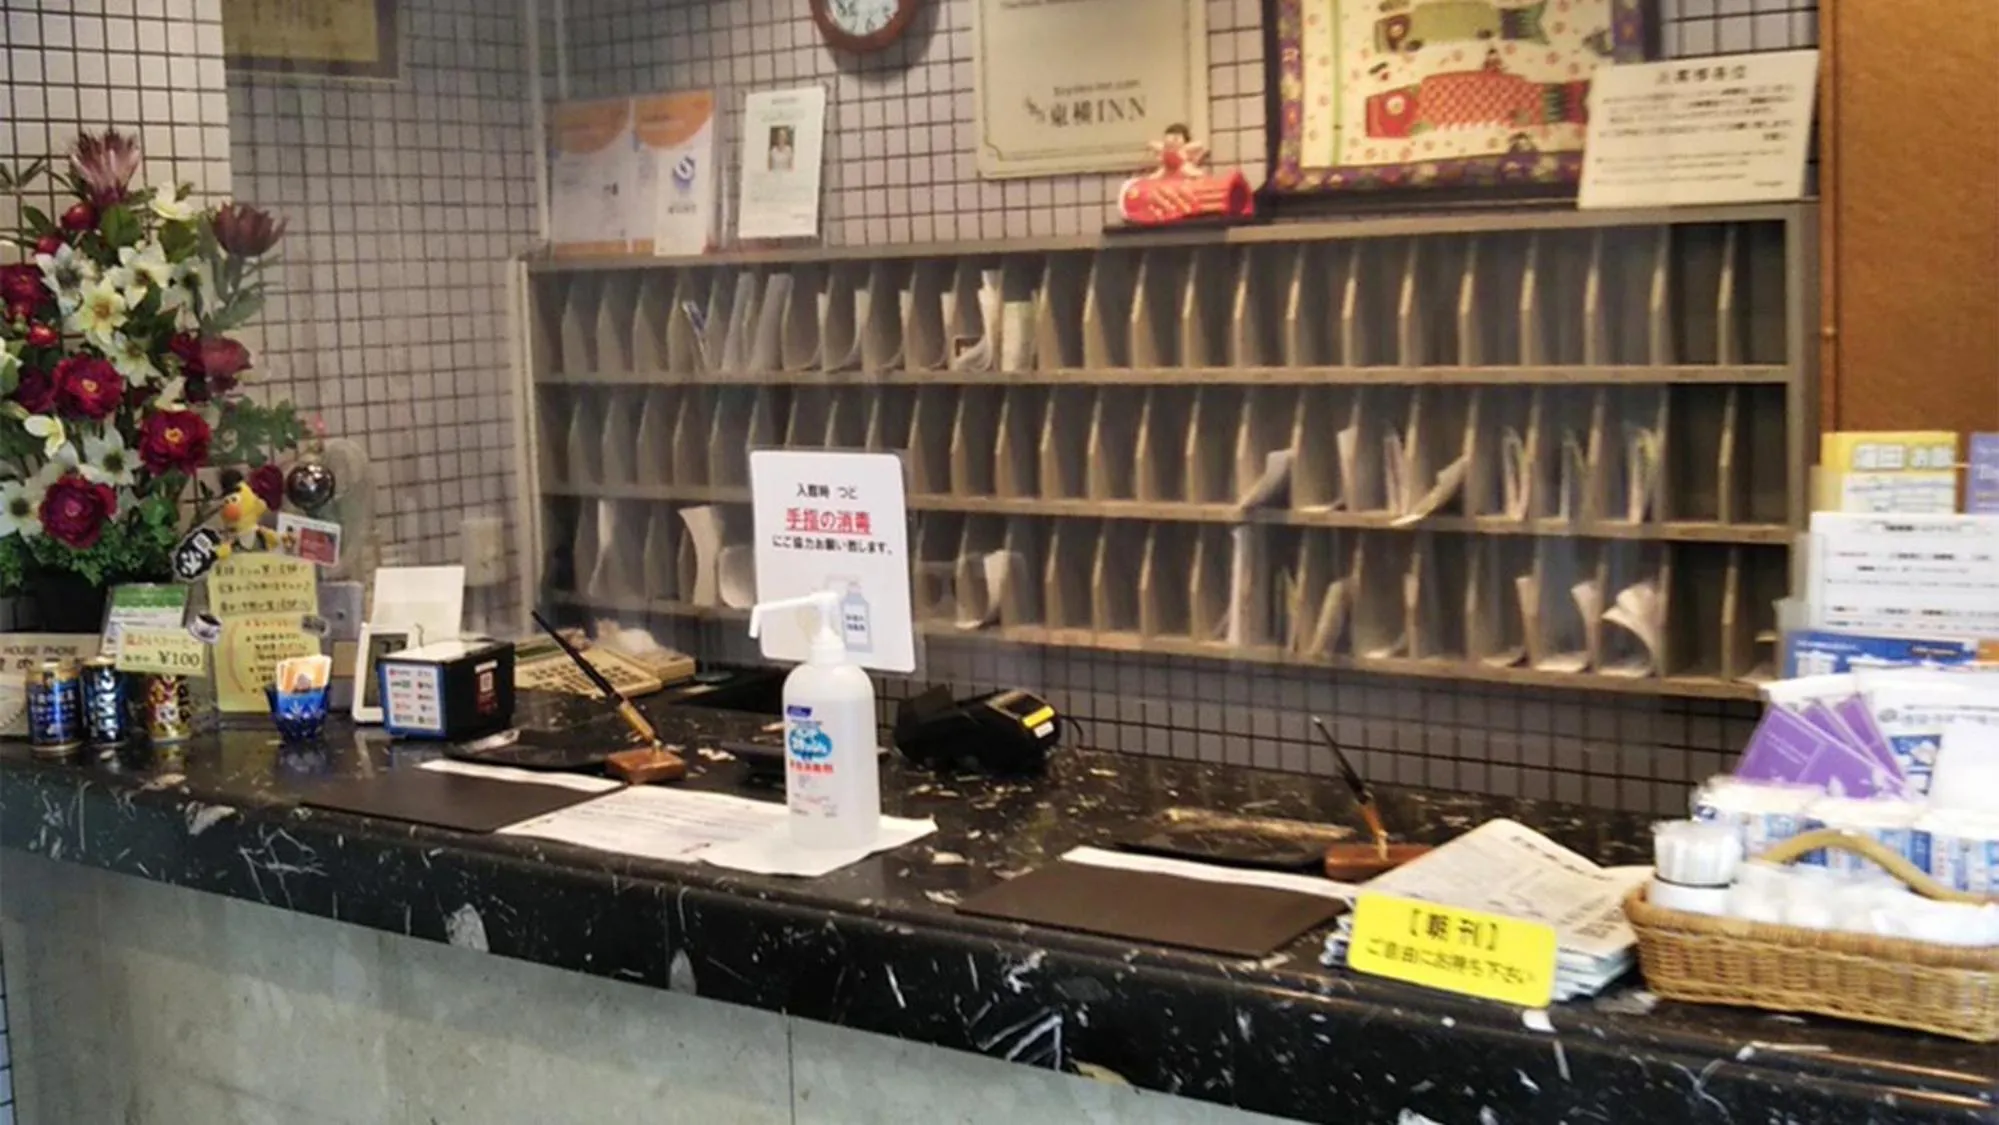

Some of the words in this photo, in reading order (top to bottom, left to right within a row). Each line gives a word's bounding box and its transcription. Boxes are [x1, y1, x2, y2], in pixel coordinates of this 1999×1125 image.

[786, 508, 871, 534] 手指の消毒
[772, 535, 893, 555] にご協力お願い致します。
[158, 650, 201, 667] ¥100
[1366, 938, 1537, 984] ご自由にお持ち下さい
